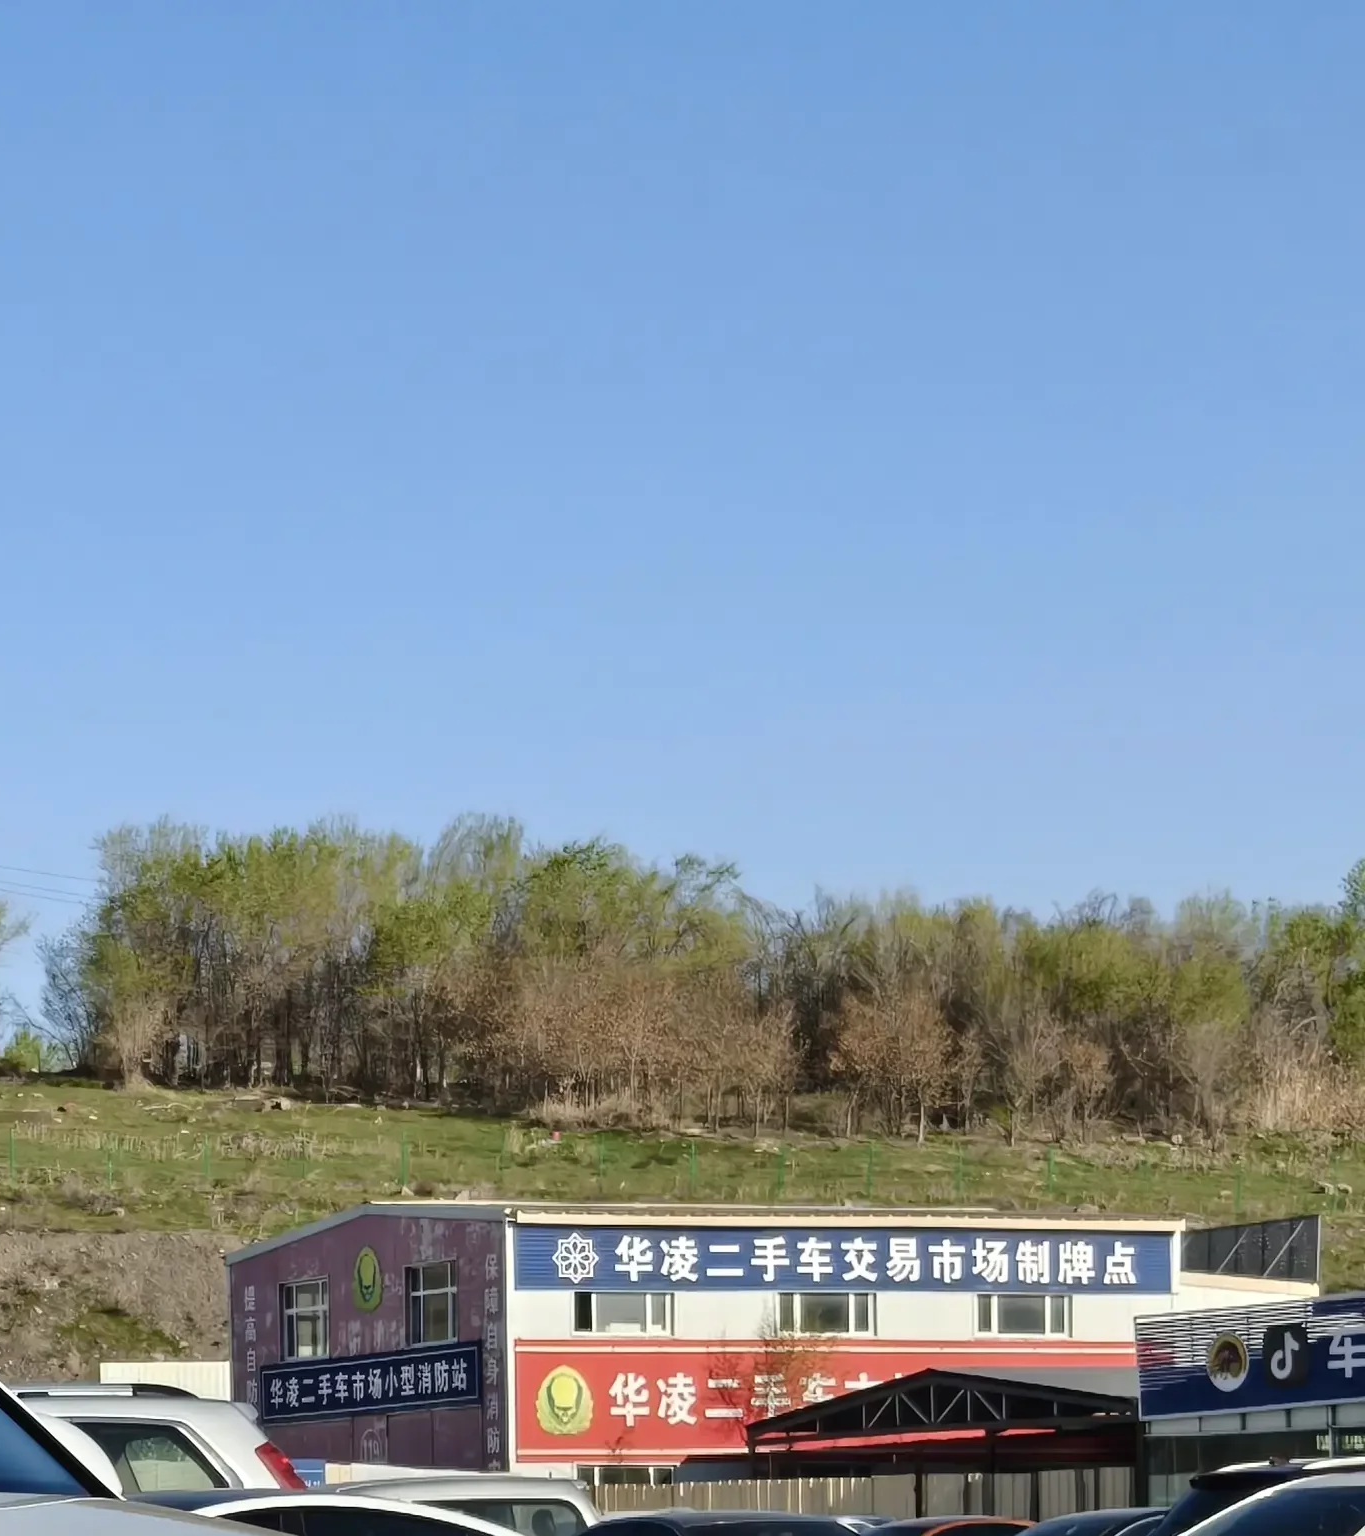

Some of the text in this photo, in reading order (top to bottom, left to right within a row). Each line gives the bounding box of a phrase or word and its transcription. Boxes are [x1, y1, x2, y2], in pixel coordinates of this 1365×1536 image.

[613, 1233, 1138, 1286] 华凌二手车交易市场制牌点
[269, 1357, 468, 1411] 华凌二手车市场小型消防站
